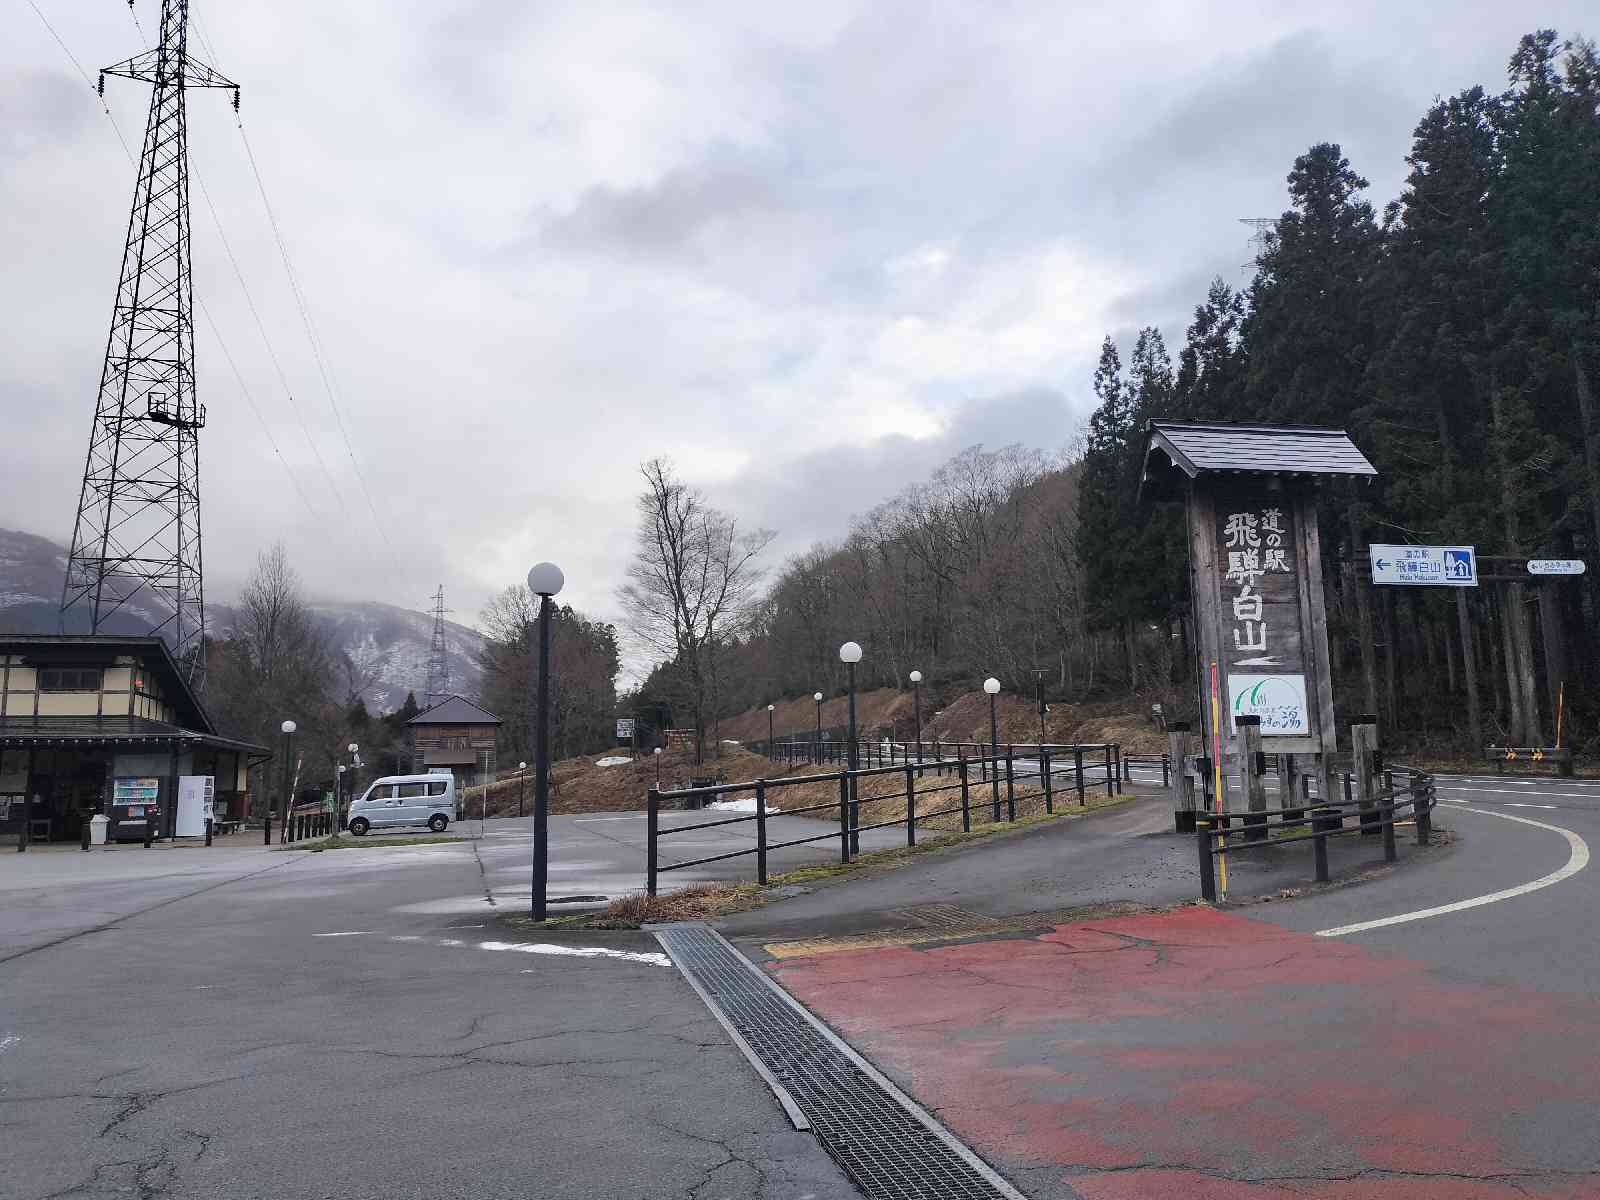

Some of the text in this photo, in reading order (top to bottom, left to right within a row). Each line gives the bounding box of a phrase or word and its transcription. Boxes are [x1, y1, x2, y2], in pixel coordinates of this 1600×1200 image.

[1224, 512, 1267, 651] 飛騨白山
[1261, 508, 1290, 572] 道の駅
